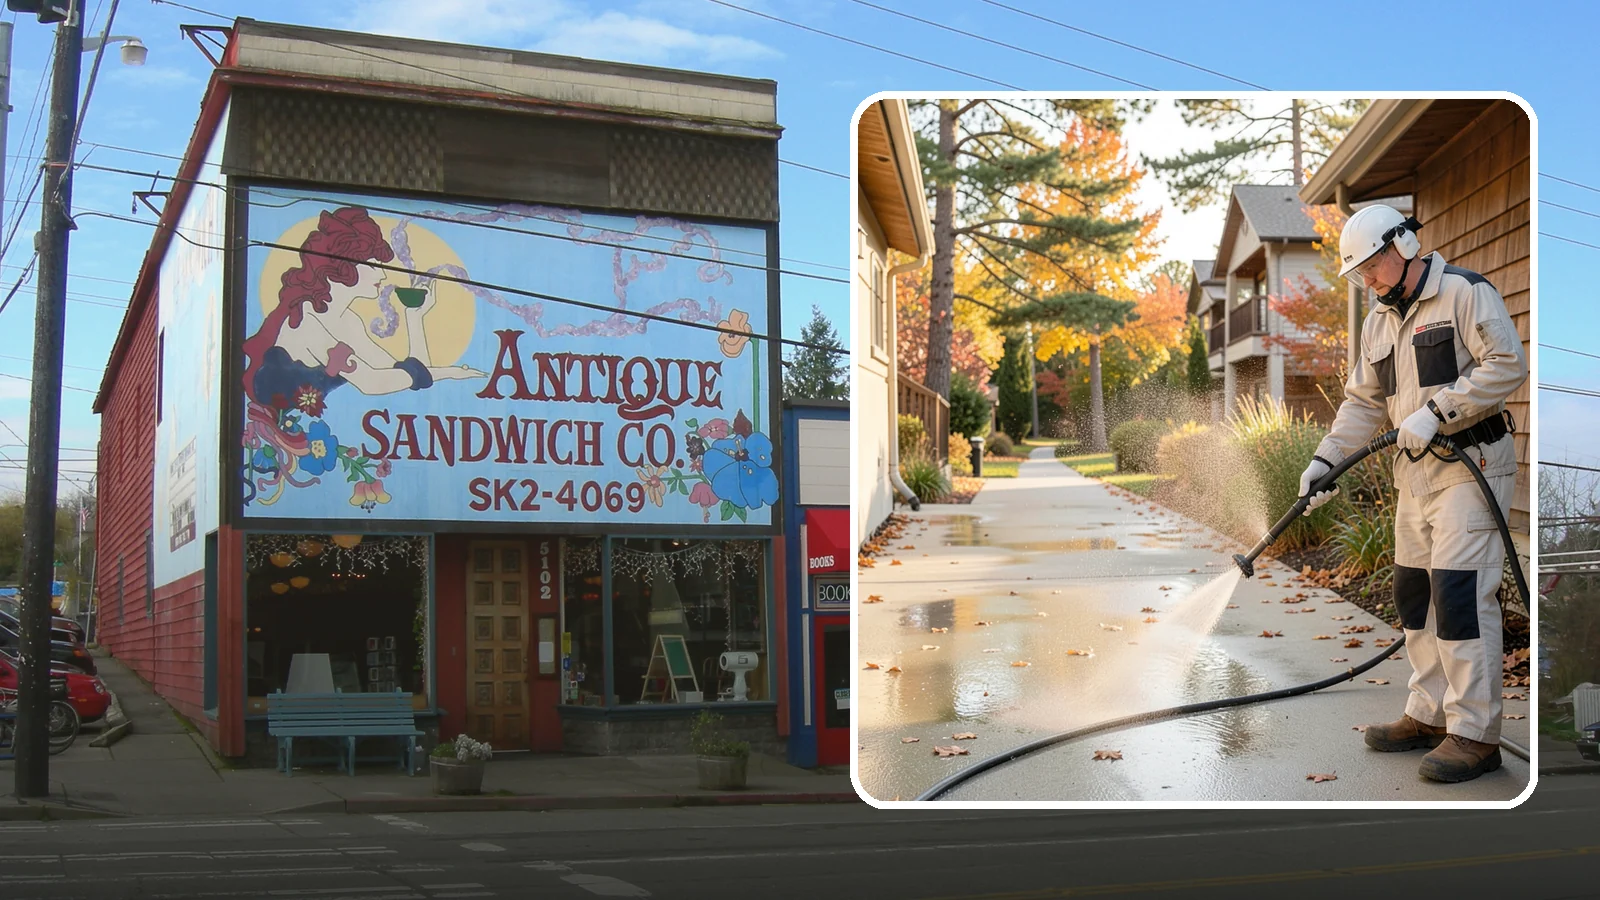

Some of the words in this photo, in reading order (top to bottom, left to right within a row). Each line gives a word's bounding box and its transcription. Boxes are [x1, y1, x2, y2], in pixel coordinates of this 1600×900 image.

[477, 329, 723, 421] ANTIQUE
[361, 409, 604, 467] SANDWICH
[617, 422, 685, 469] CO.
[468, 478, 646, 513] SK2-4069
[540, 541, 551, 600] 5102
[809, 555, 835, 569] BOOKS
